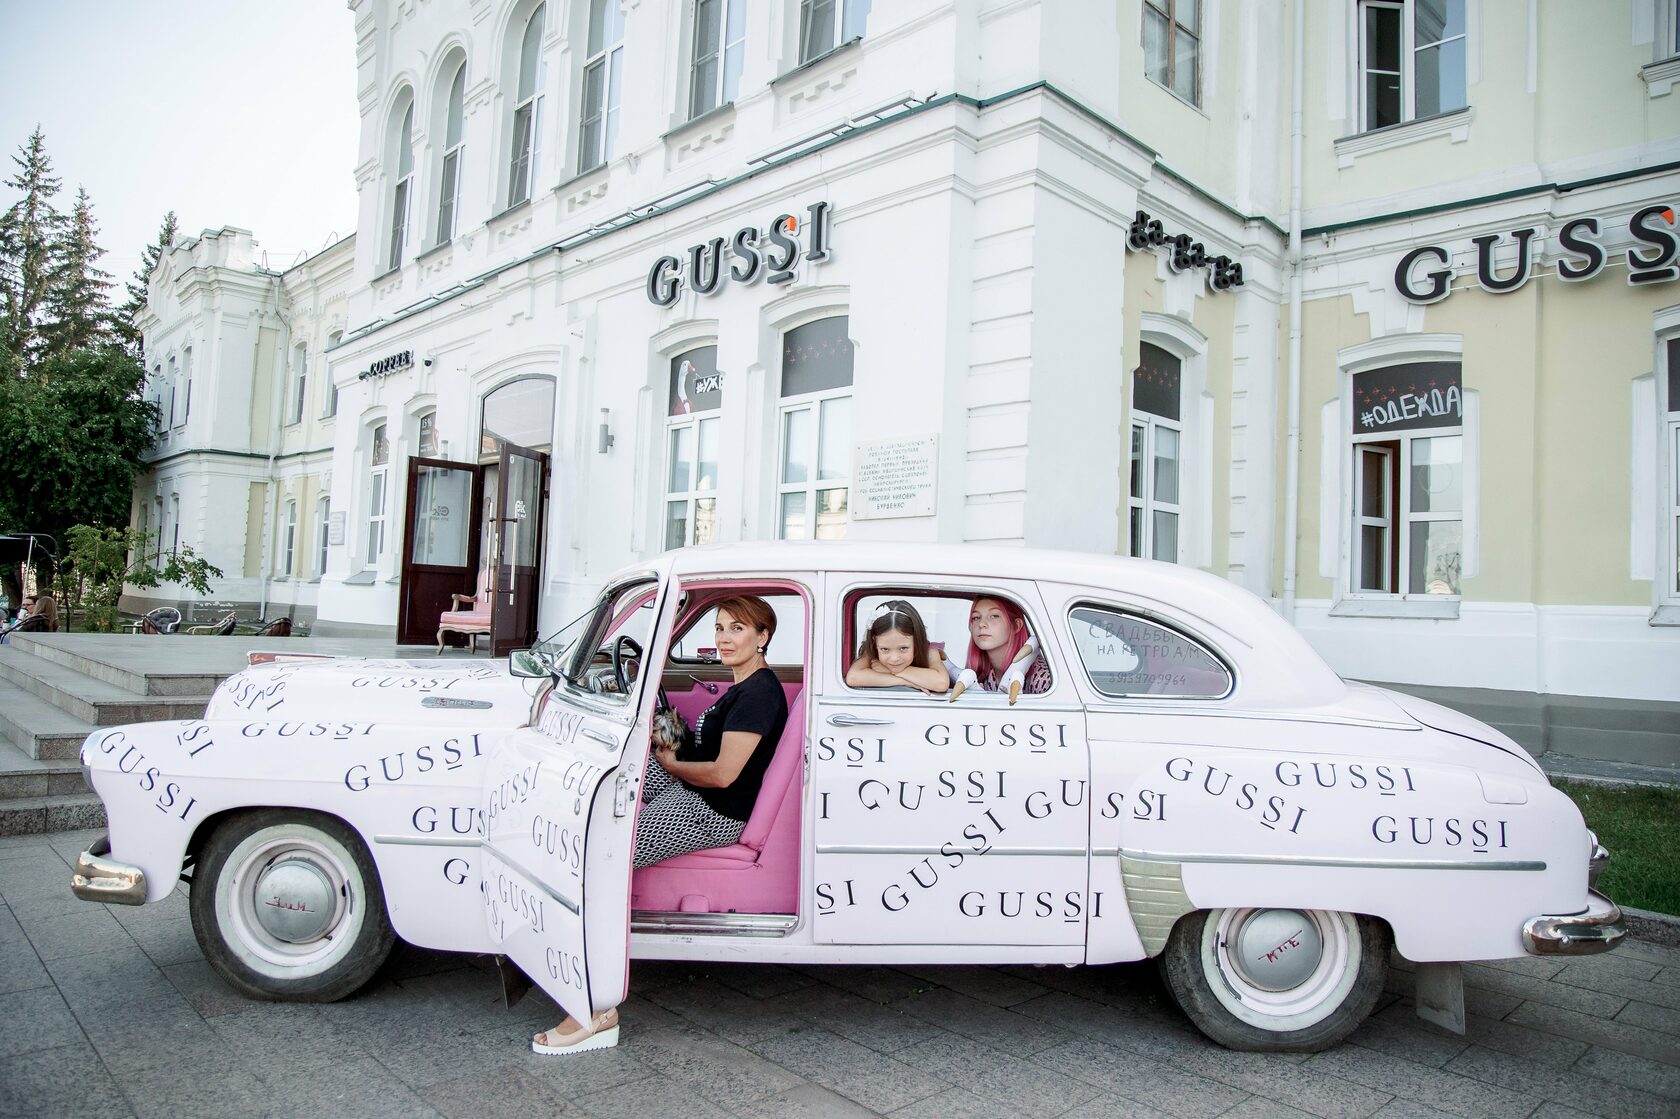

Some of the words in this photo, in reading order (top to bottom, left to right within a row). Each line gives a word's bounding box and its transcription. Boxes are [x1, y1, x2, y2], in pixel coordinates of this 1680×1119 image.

[647, 201, 830, 306] GUSSI
[1394, 204, 1678, 300] GUSS
[1361, 386, 1462, 427] #ОДЕЖДА
[1097, 644, 1115, 656] НА
[352, 676, 460, 692] GUSSI
[242, 722, 377, 740] GUSSI
[817, 736, 887, 767] SSI
[925, 723, 1068, 753] GUSSI
[100, 731, 198, 821] GUSSI
[345, 733, 483, 792] GUSSI
[562, 761, 601, 796] GU
[1275, 760, 1416, 796] GUSSI
[489, 761, 542, 818] GUSSI
[1165, 757, 1308, 834] GUSSI
[532, 815, 581, 877] GUSS
[1372, 815, 1509, 853] GUSSI
[881, 807, 1007, 912] GUSSI
[498, 874, 545, 933] GUSSI
[816, 879, 857, 915] SI
[959, 891, 1104, 922] GUSSI
[546, 947, 583, 990] GUS
